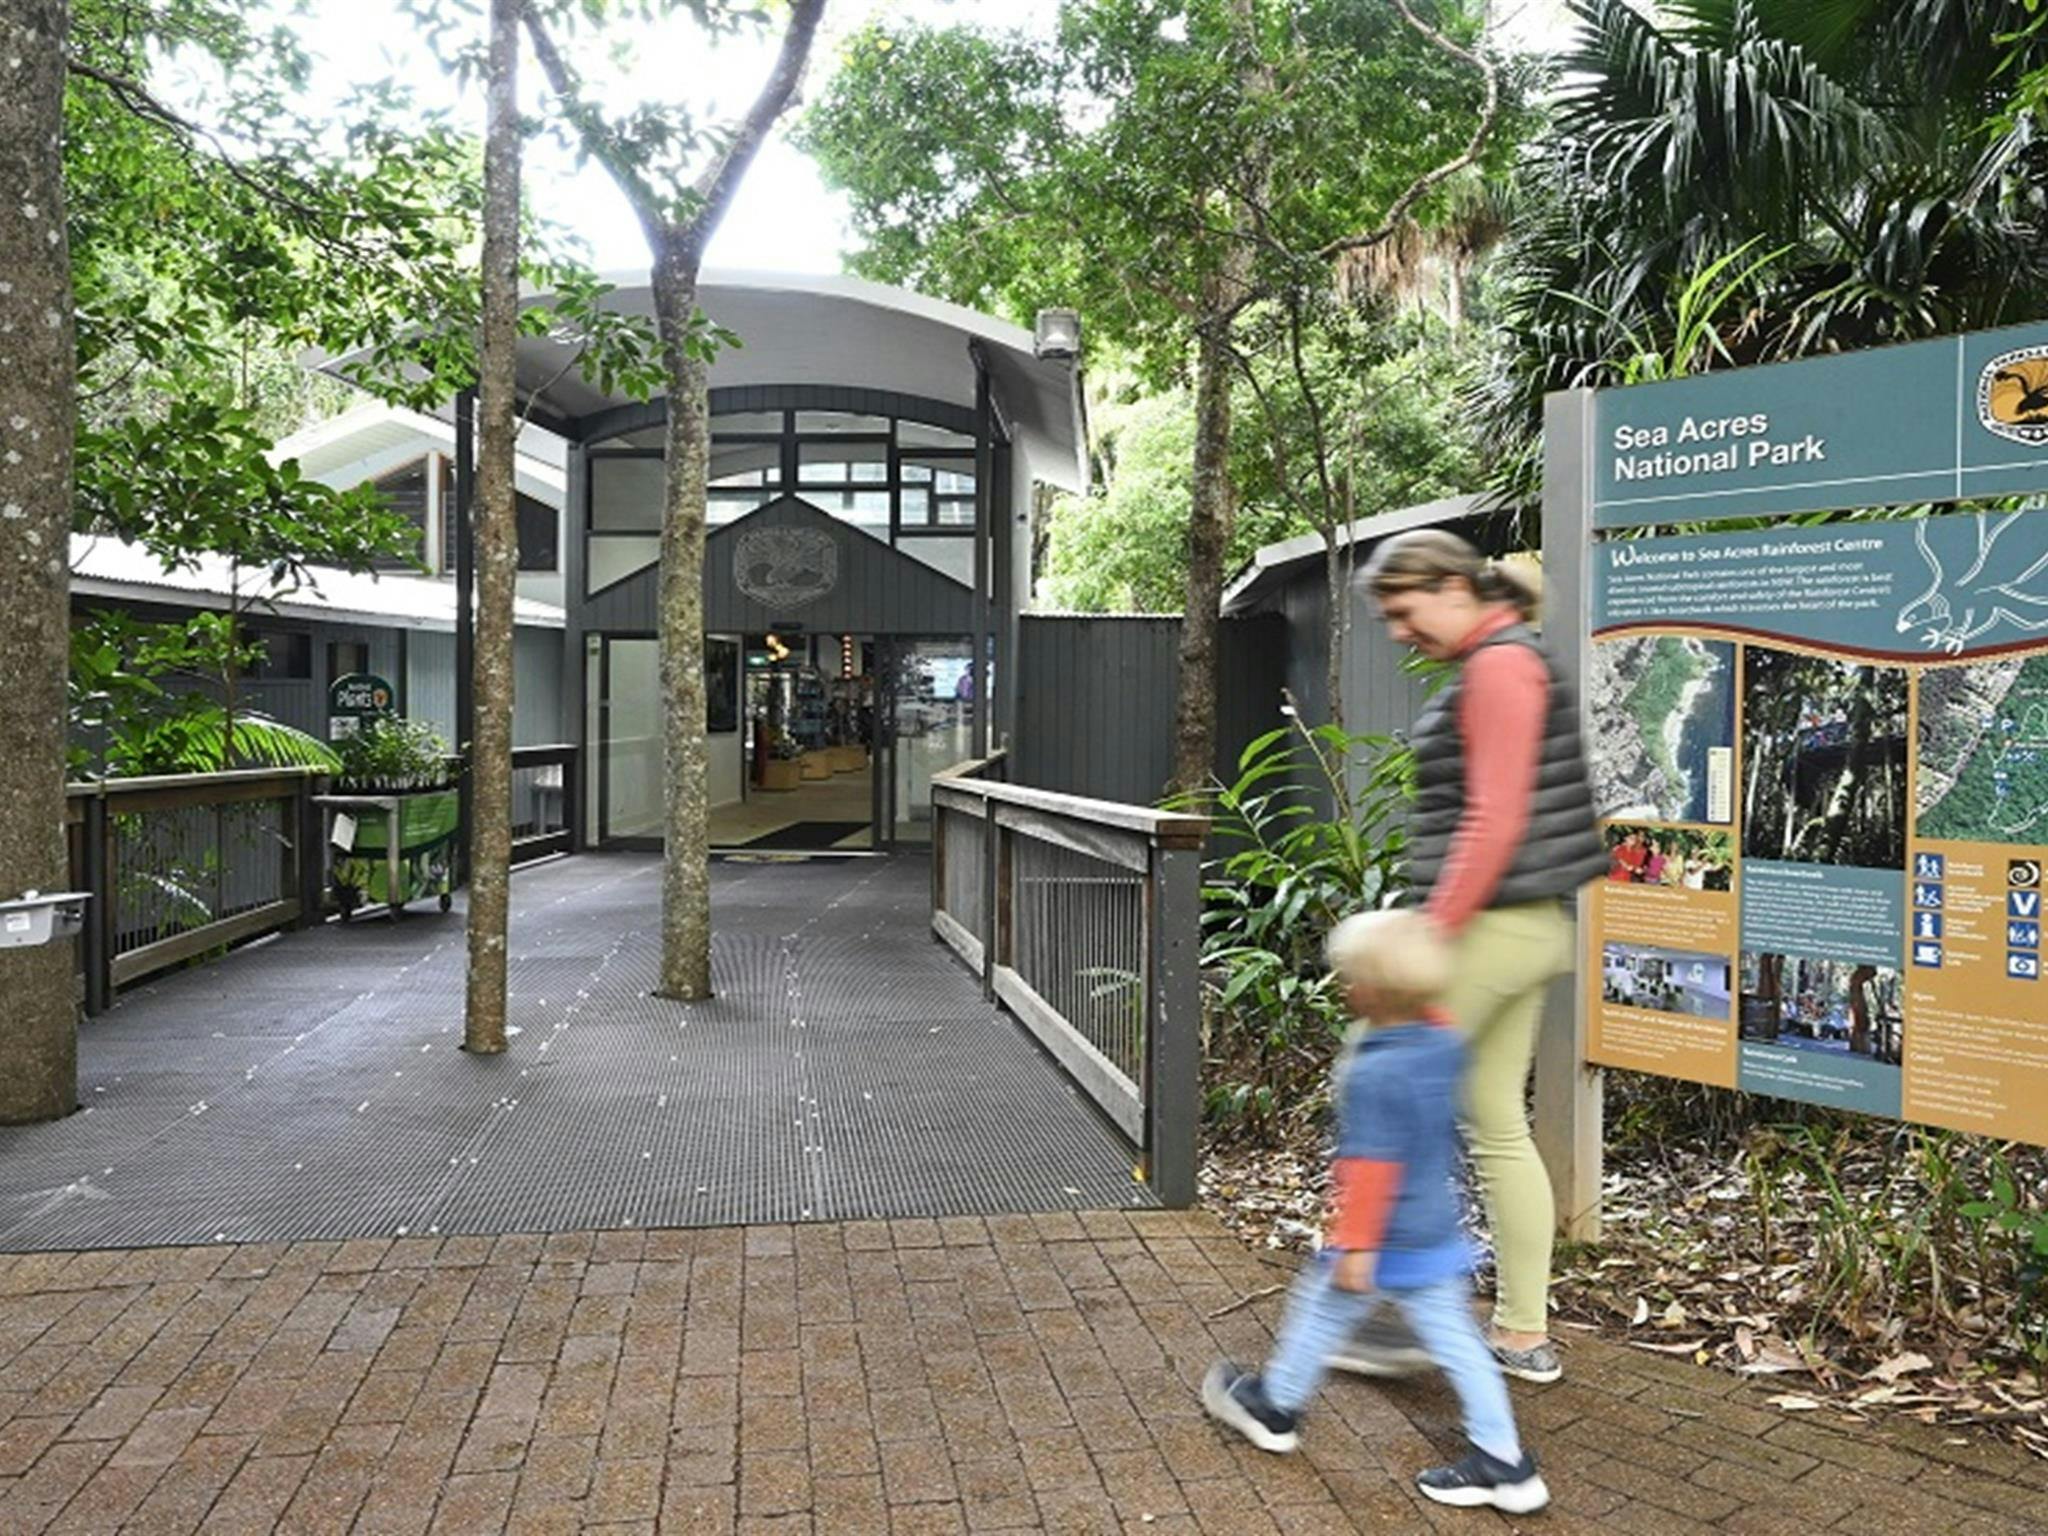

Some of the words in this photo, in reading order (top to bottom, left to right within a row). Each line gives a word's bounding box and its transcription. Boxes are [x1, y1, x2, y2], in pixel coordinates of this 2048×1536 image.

[1614, 424, 1668, 450] Sea
[1677, 413, 1768, 443] Acres
[1614, 444, 1738, 482] National
[1749, 434, 1825, 467] Park
[1611, 544, 1680, 568] Welcome
[1682, 549, 1696, 561] to
[1698, 546, 1721, 561] Sea
[1723, 546, 1759, 559] Acres
[1761, 541, 1832, 556] Rainforest
[1833, 537, 1883, 552] Centre
[336, 690, 372, 707] Plants
